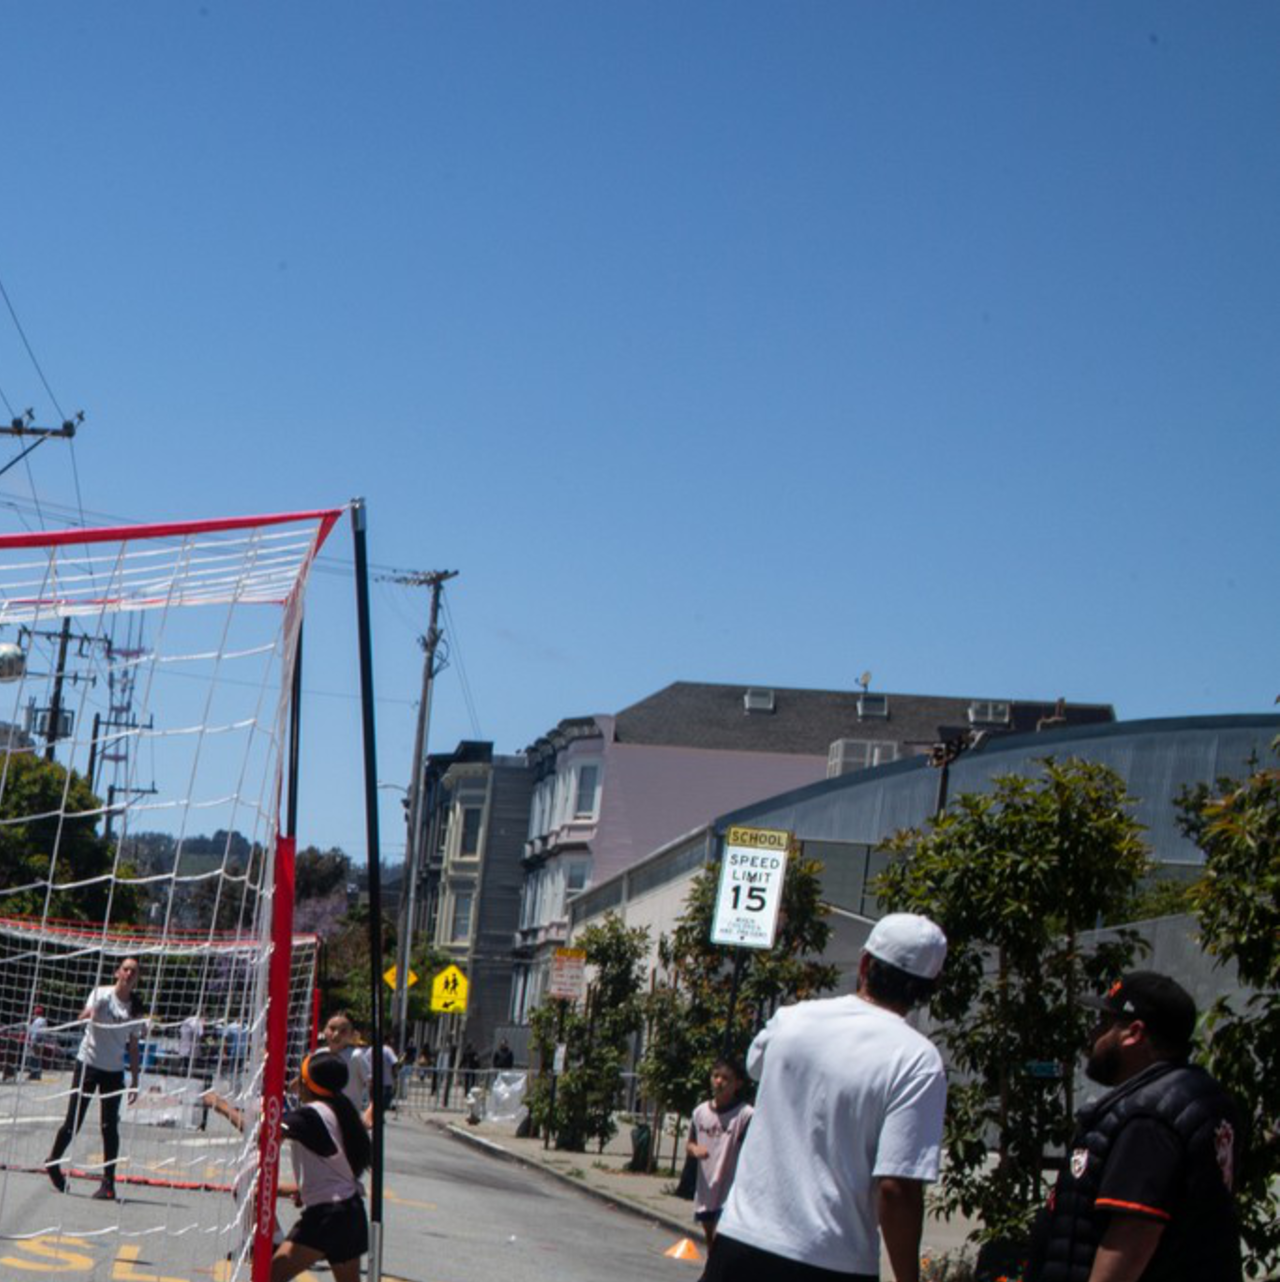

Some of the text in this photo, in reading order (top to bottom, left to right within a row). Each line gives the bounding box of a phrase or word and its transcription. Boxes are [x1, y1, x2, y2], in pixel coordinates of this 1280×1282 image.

[731, 830, 784, 846] SCHOOL
[730, 853, 780, 870] SPEED
[731, 869, 773, 883] LIMIT
[731, 885, 767, 912] 15
